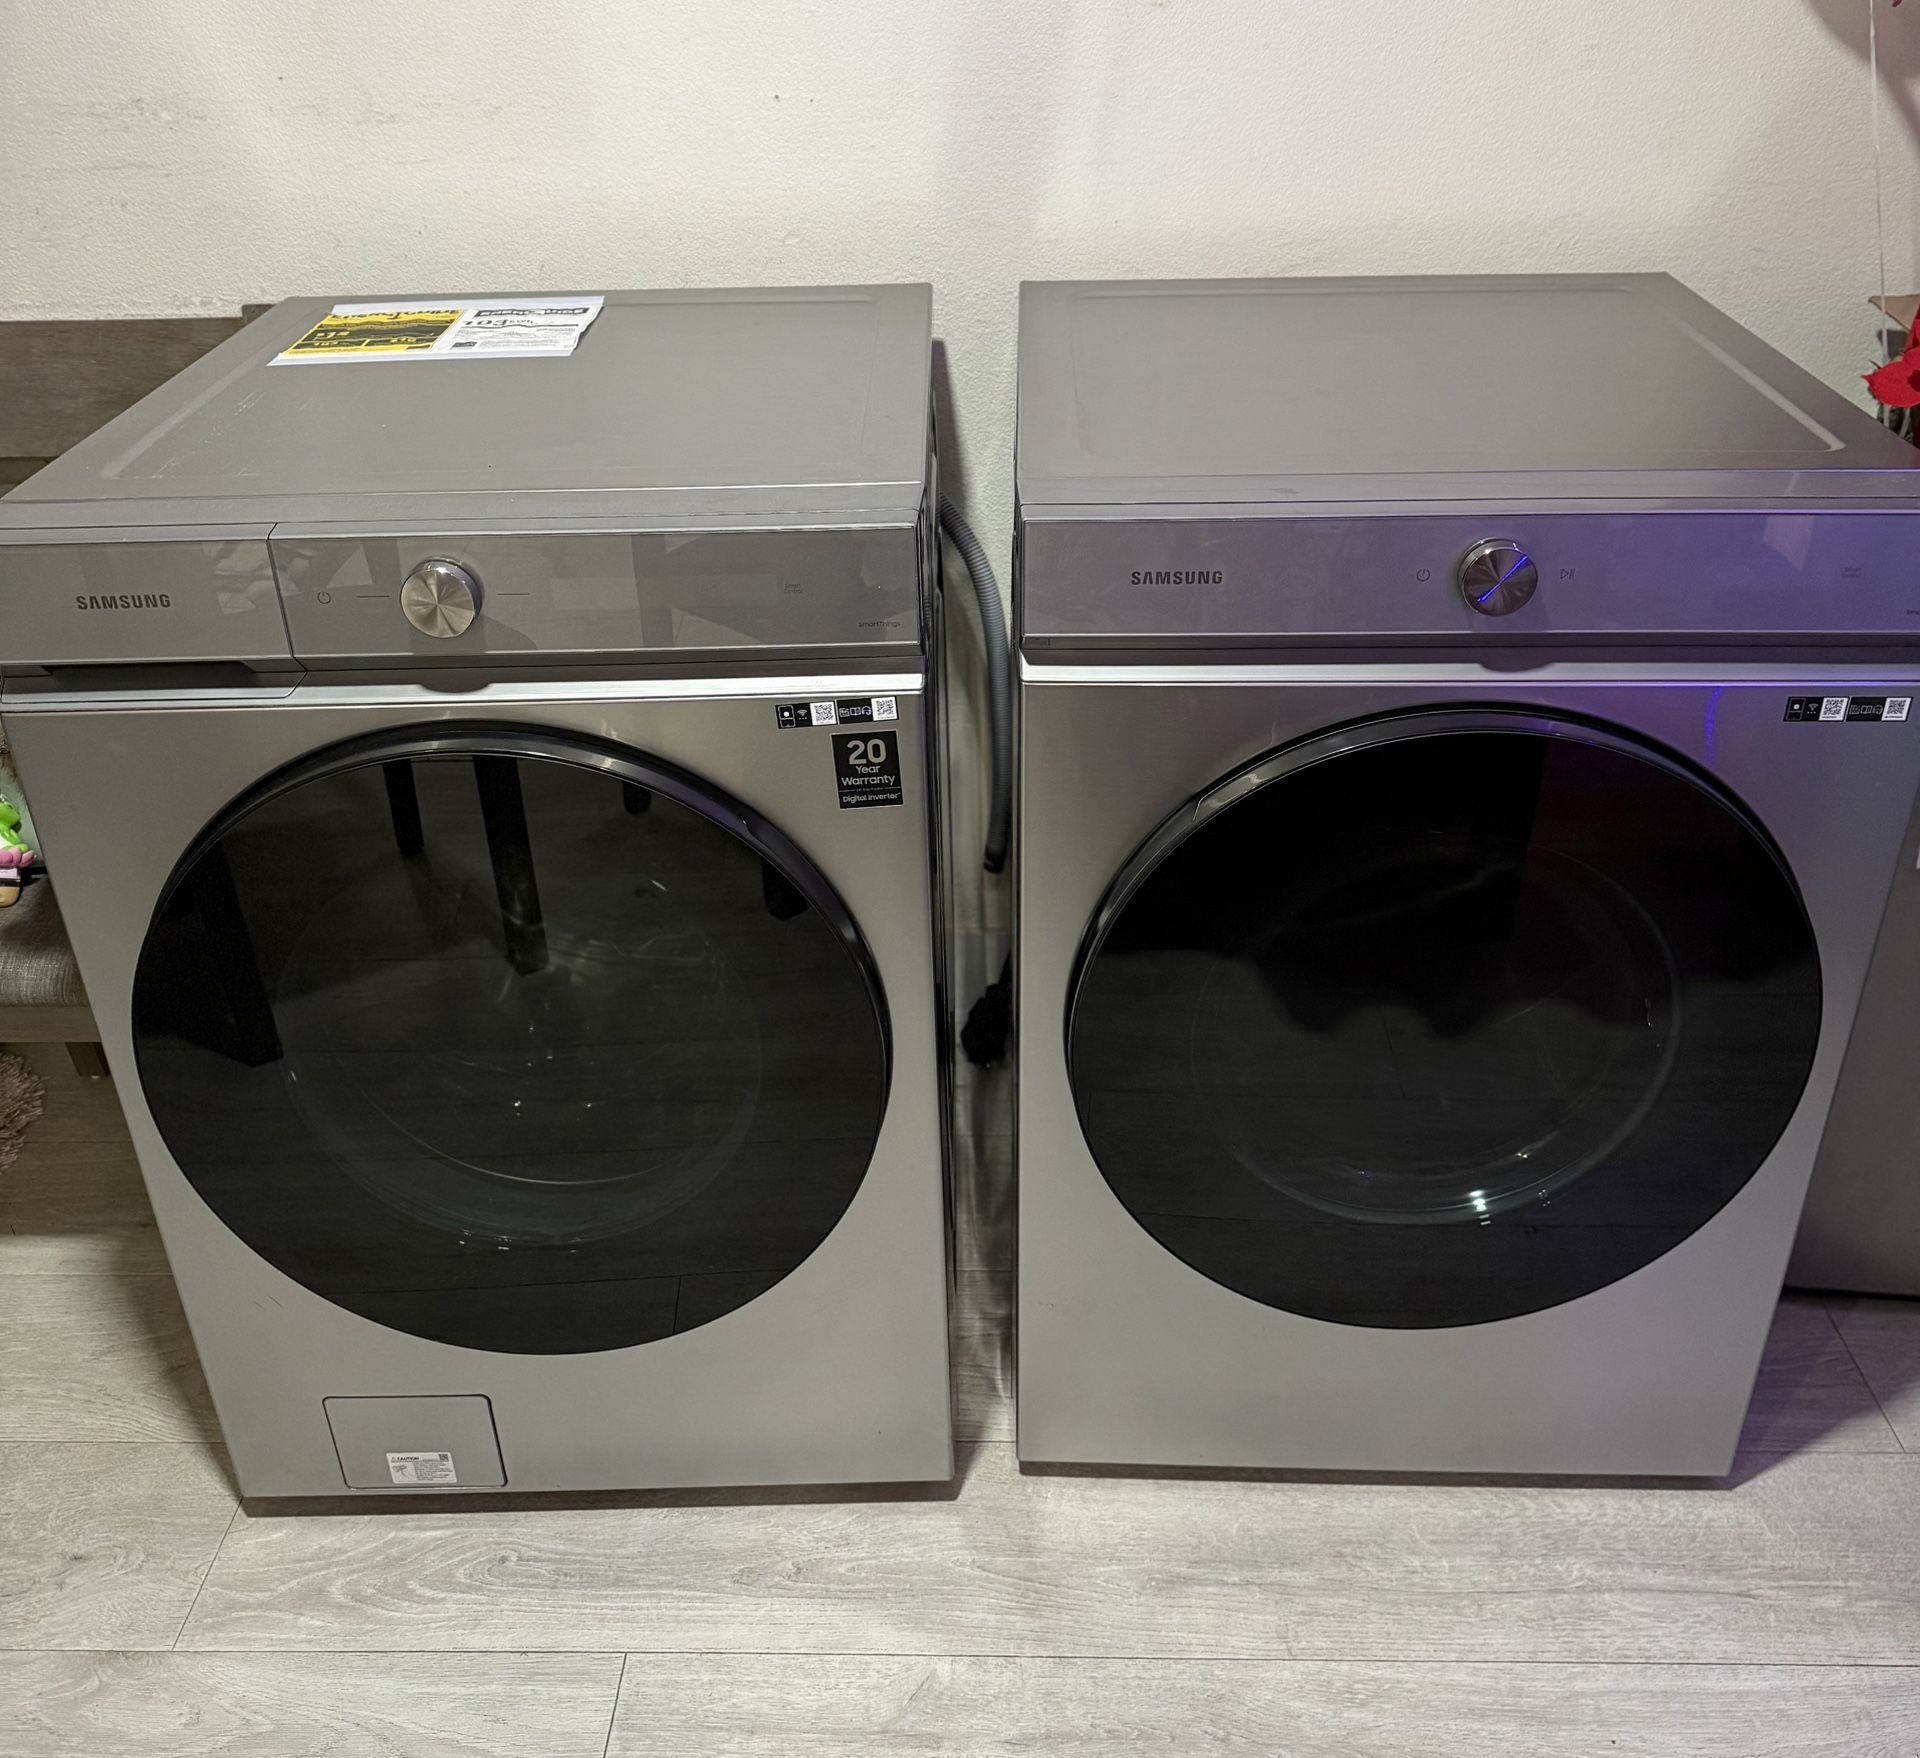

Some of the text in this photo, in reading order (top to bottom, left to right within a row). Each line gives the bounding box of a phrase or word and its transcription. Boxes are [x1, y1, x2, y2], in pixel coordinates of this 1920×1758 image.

[1131, 571, 1223, 585] SAMSUNG
[76, 594, 171, 610] SAMSUNG
[846, 738, 886, 765] 20
[855, 765, 880, 774] Year
[841, 775, 895, 786] Warranty
[842, 794, 867, 803] Digital
